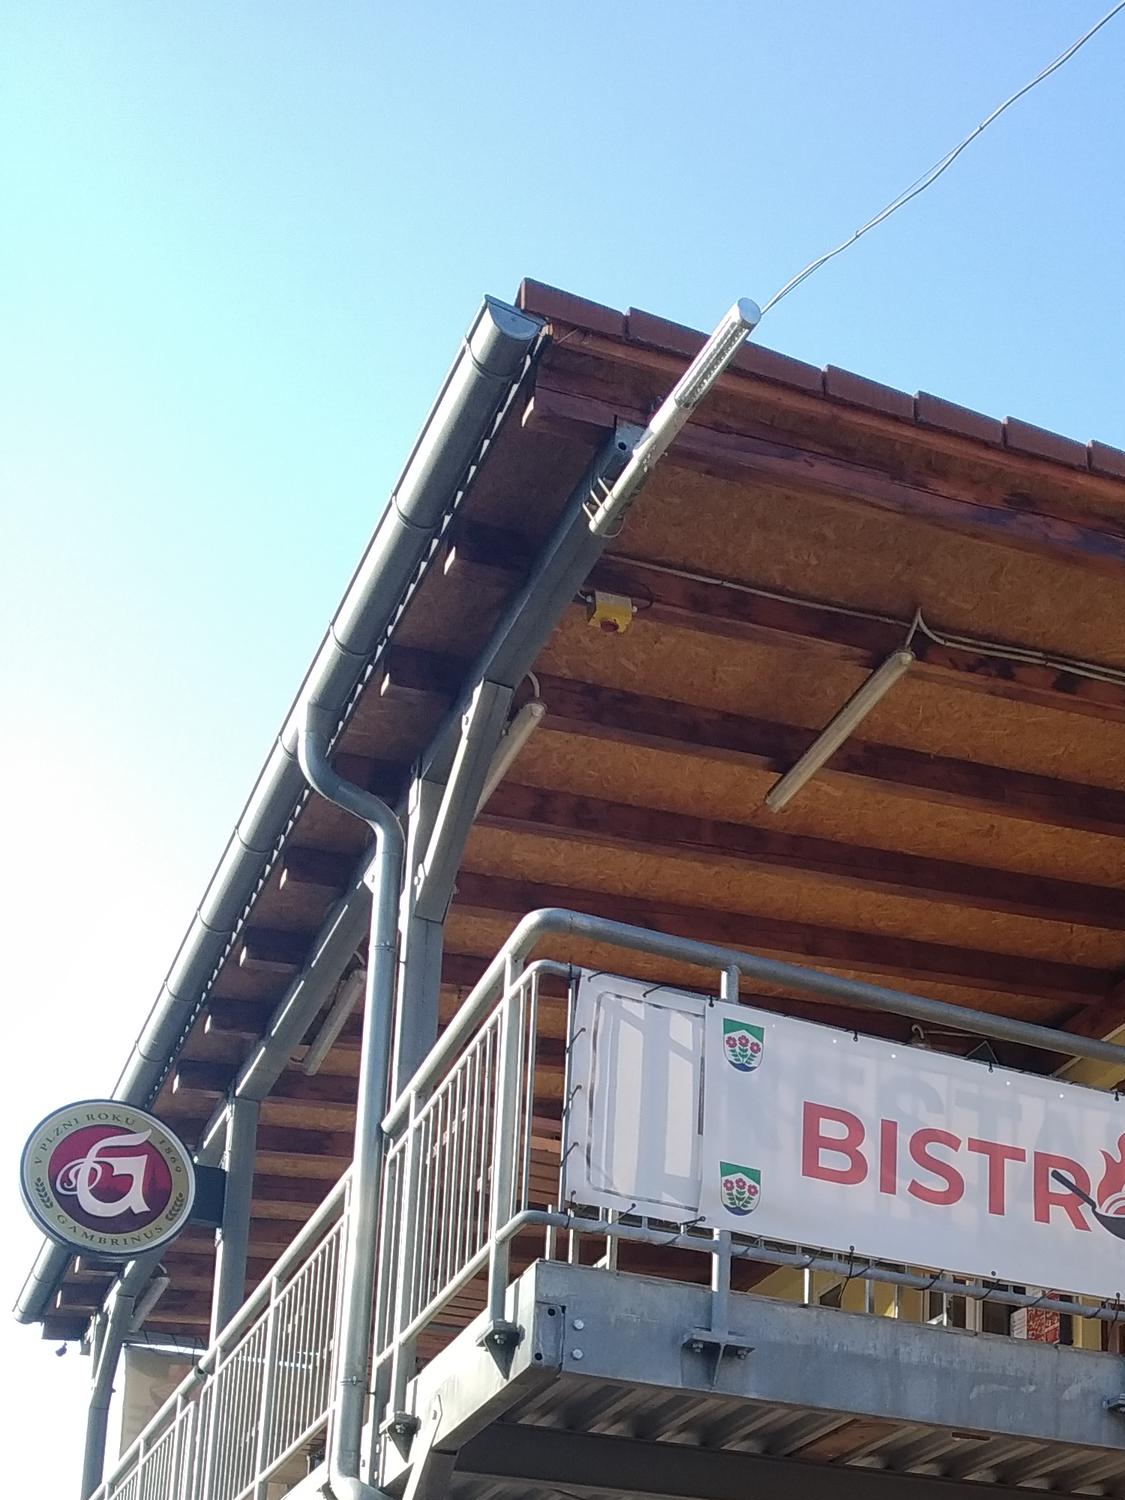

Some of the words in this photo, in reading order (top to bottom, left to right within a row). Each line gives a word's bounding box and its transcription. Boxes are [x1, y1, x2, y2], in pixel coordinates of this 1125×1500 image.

[34, 1156, 43, 1166] V
[40, 1117, 79, 1153] PLZNI
[86, 1112, 136, 1126] ROKU
[158, 1138, 183, 1174] 1869
[56, 1214, 163, 1246] GAMBRINUS
